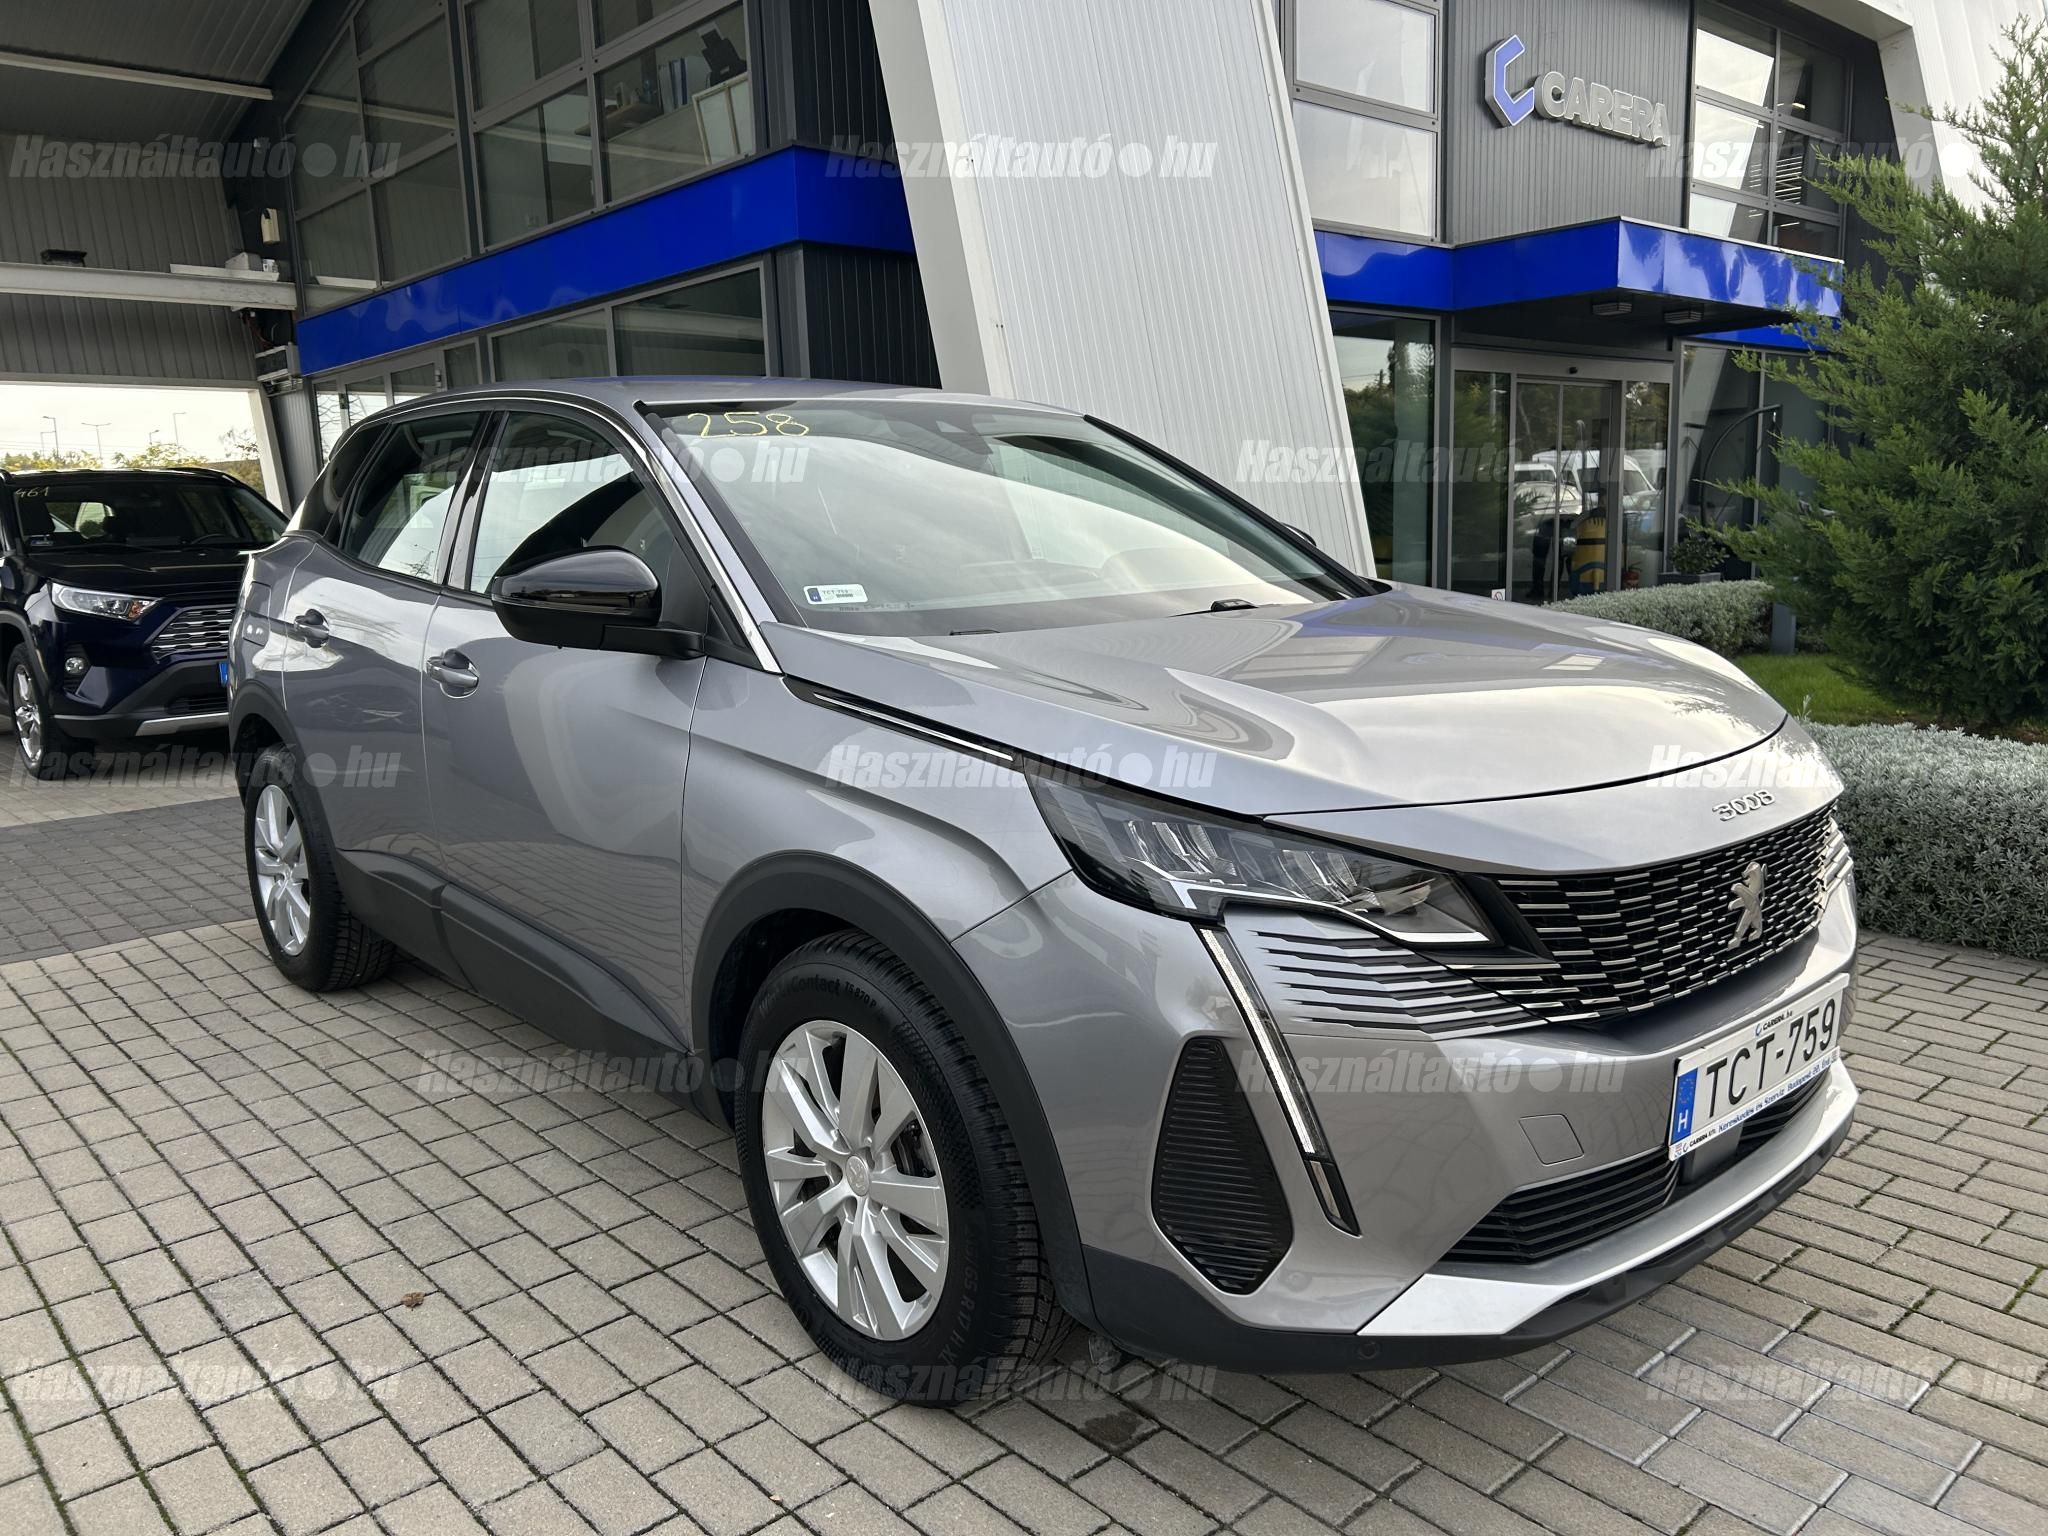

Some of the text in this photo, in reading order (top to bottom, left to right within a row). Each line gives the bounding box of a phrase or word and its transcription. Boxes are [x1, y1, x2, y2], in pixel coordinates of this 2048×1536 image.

[1538, 71, 1671, 147] CARERA
[687, 412, 810, 439] 258
[15, 486, 50, 498] 461
[1712, 789, 1775, 821] 3008
[1706, 998, 1835, 1118] TCT-759
[1677, 1109, 1689, 1133] H
